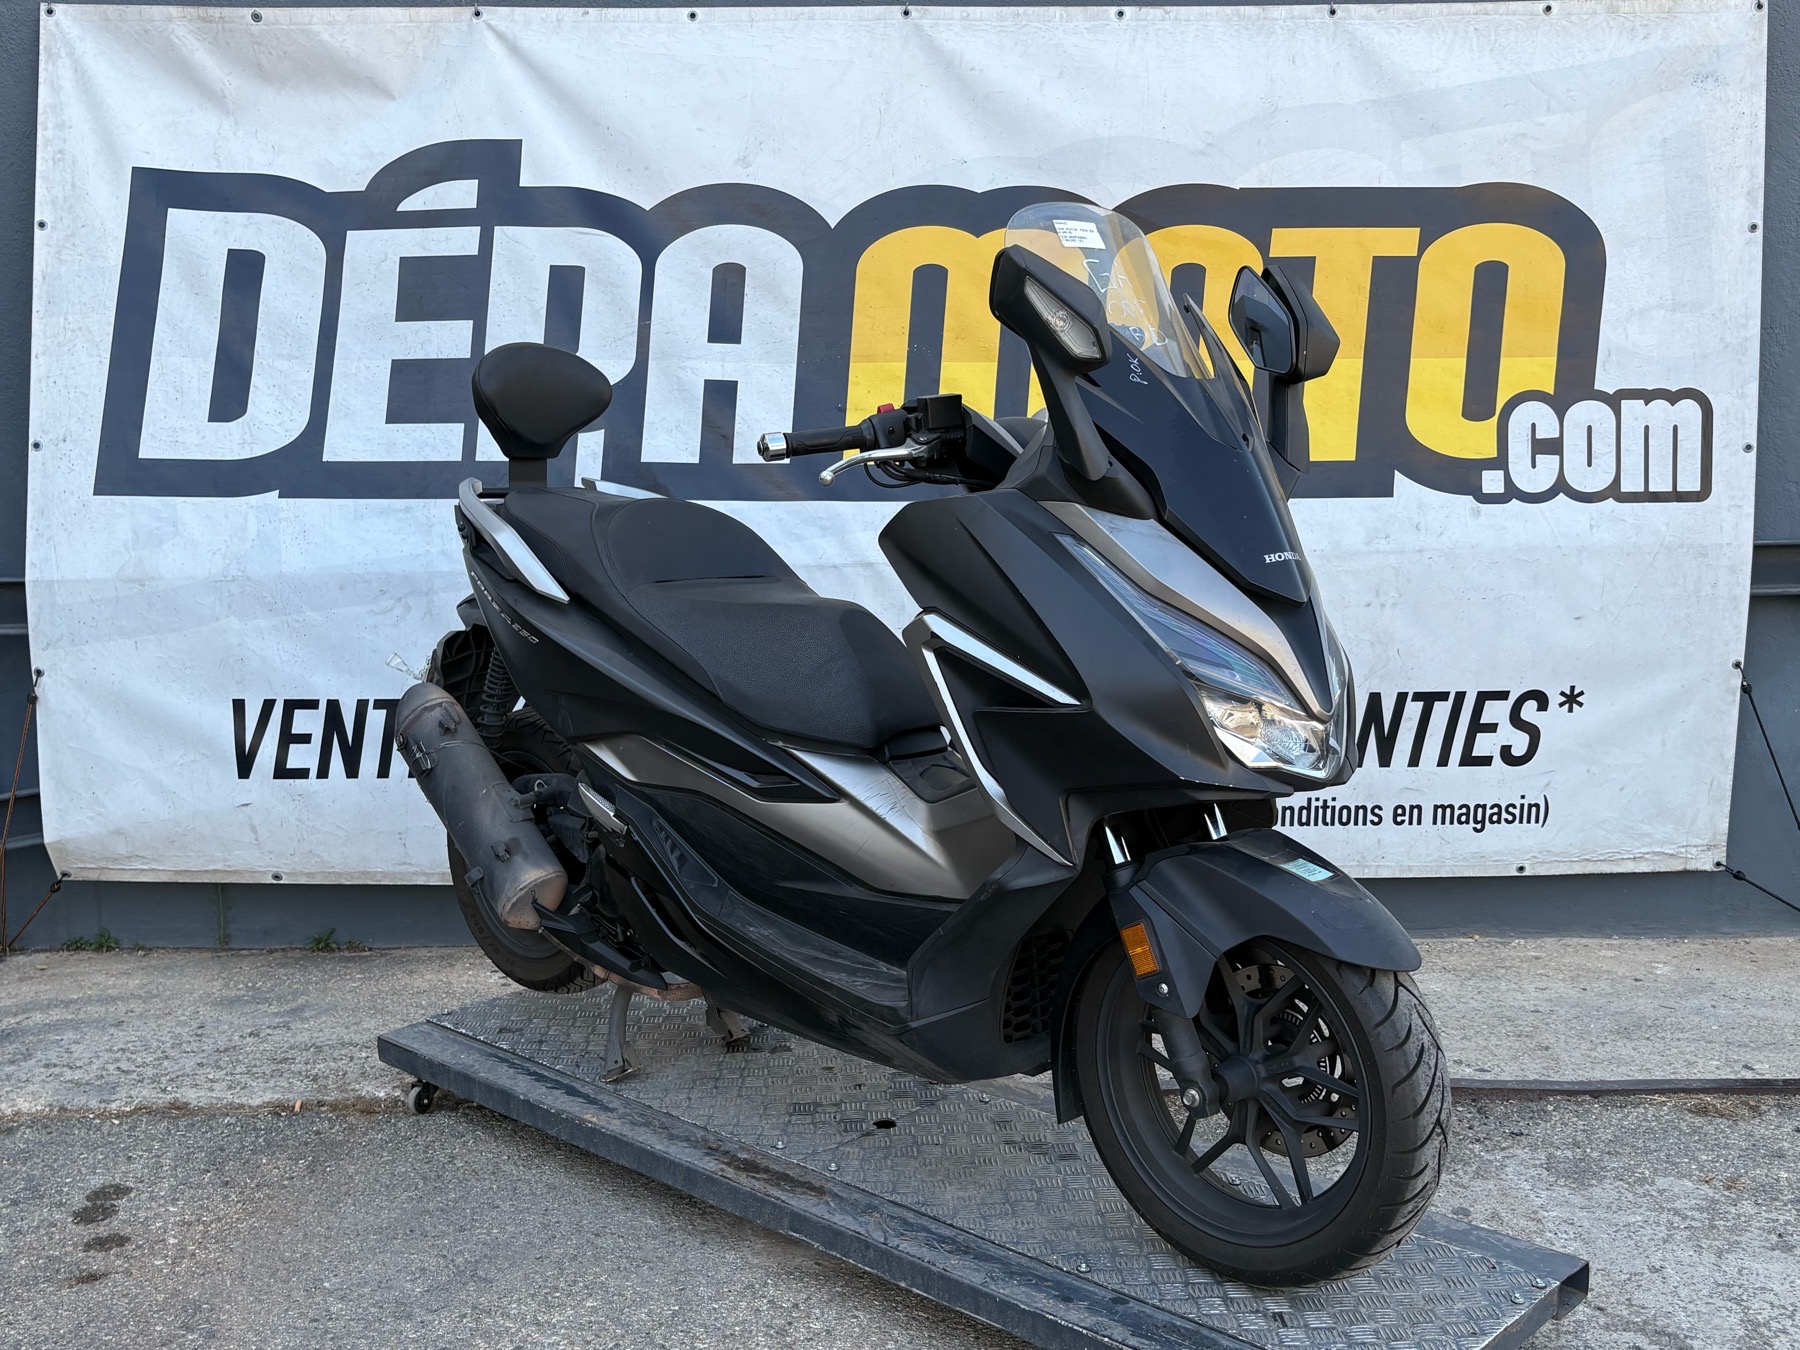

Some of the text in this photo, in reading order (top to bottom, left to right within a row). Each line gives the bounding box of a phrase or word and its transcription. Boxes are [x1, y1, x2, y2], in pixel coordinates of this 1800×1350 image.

[1263, 551, 1302, 563] HONDA
[232, 698, 416, 780] VENT
[1357, 685, 1585, 768] NTIES
[1276, 794, 1550, 834] nditions en magasin)
